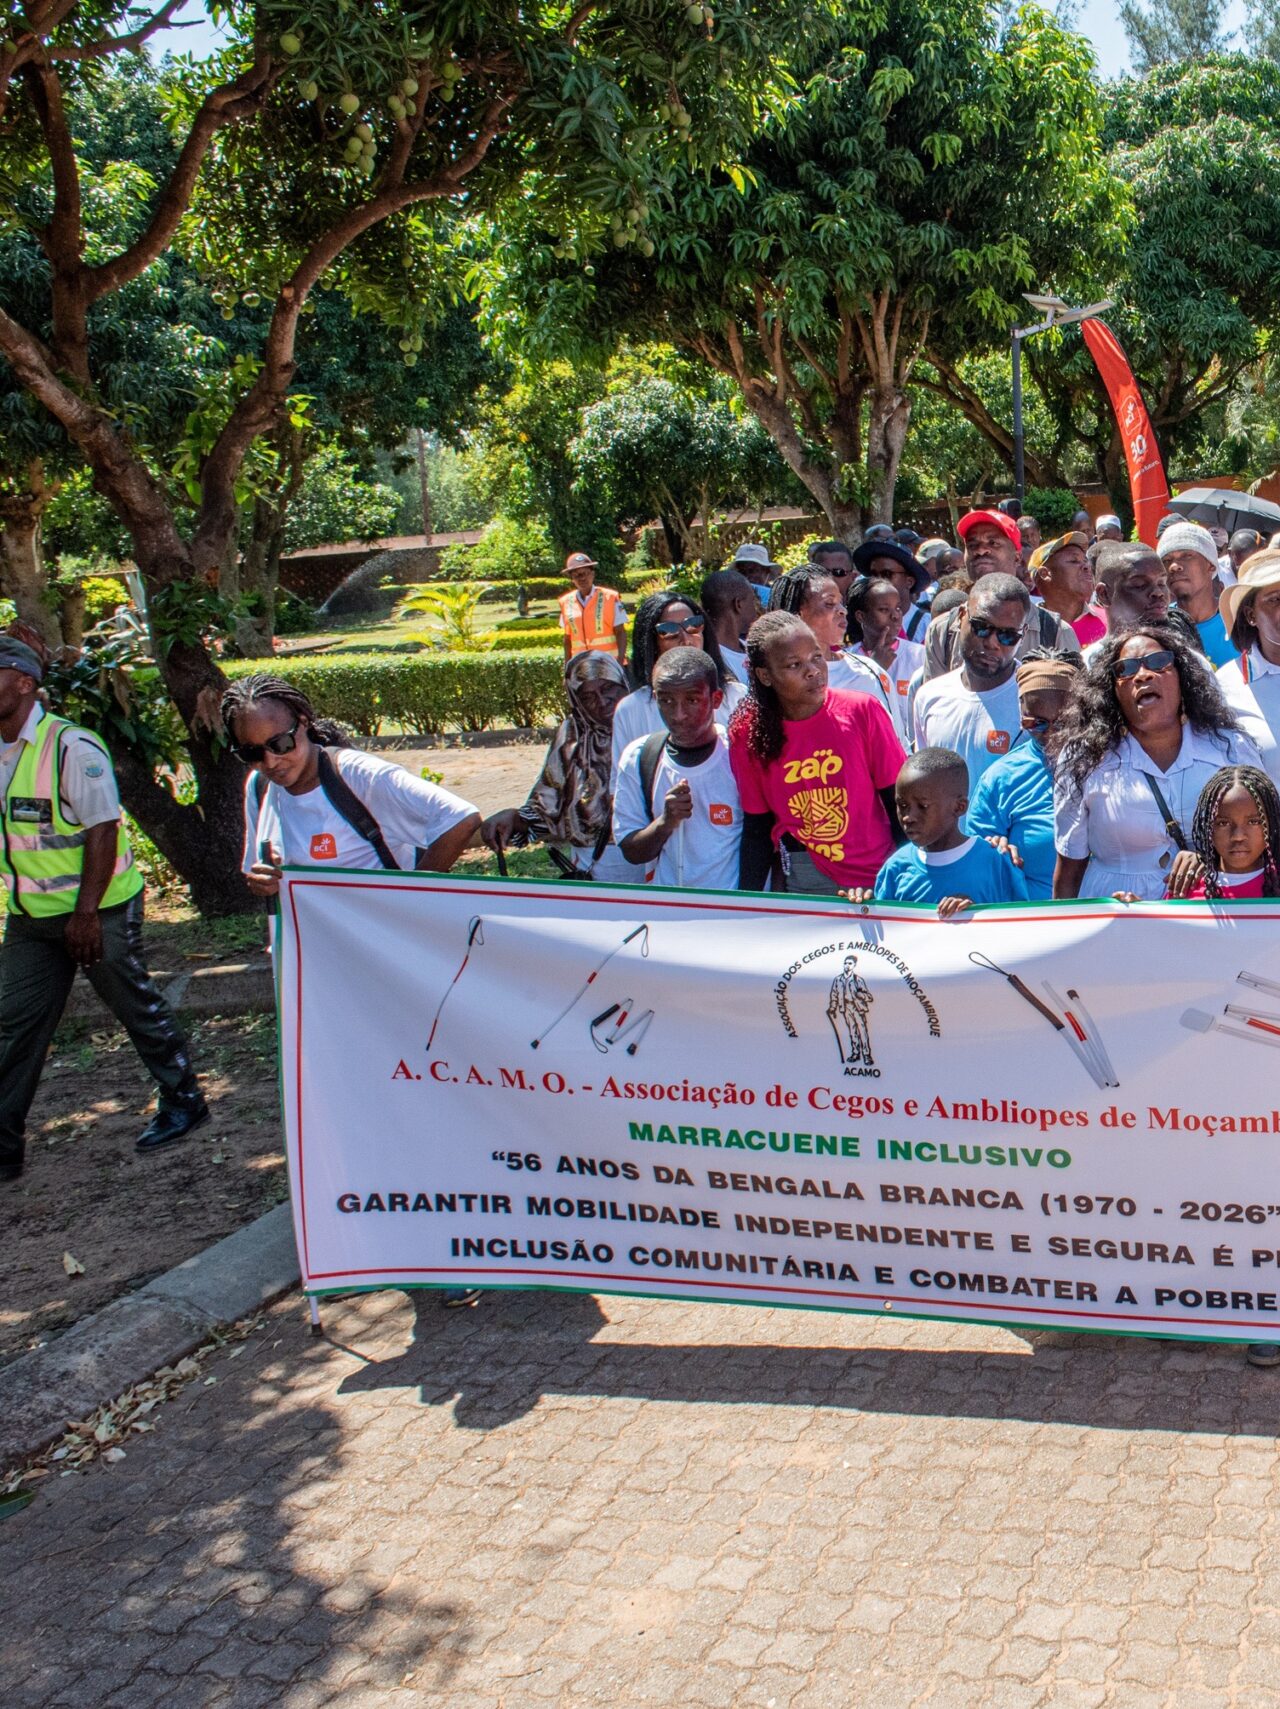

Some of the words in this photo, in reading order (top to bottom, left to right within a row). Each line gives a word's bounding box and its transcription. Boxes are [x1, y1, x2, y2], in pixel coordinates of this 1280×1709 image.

[782, 960, 803, 982] DOS
[801, 943, 836, 965] CEGOS
[838, 941, 846, 951] E
[895, 961, 910, 977] DE
[774, 981, 799, 1039] ASSOCIAÇÃO
[903, 972, 942, 1039] MOÇAMBIQUE
[843, 1066, 881, 1079] ACAMO
[600, 1077, 755, 1108] Associação
[766, 1085, 798, 1107] de
[808, 1087, 893, 1118] Cegos
[904, 1100, 918, 1116] e
[926, 1096, 1088, 1131] Ambliopes
[1100, 1107, 1136, 1128] de
[629, 1122, 860, 1157] MARRACUENE
[877, 1139, 1071, 1168] INCLUSIVO
[492, 1151, 542, 1171] “56
[557, 1156, 639, 1180] ANOS
[653, 1166, 694, 1186] DA
[707, 1171, 864, 1200] BENGALA
[880, 1184, 1024, 1210] BRANCA
[1041, 1193, 1136, 1216] (1970
[337, 1193, 511, 1213] GARANTIR
[527, 1197, 720, 1228] MOBILIDADE
[734, 1214, 994, 1251] INDEPENDENTE
[1011, 1235, 1031, 1253] E
[1048, 1237, 1195, 1265] SEGURA
[1213, 1245, 1234, 1267] É
[452, 1238, 613, 1263] INCLUSÃO
[628, 1246, 859, 1285] COMUNITÁRIA
[875, 1266, 894, 1284] E
[909, 1269, 1097, 1303] COMBATER
[1115, 1286, 1138, 1304] A
